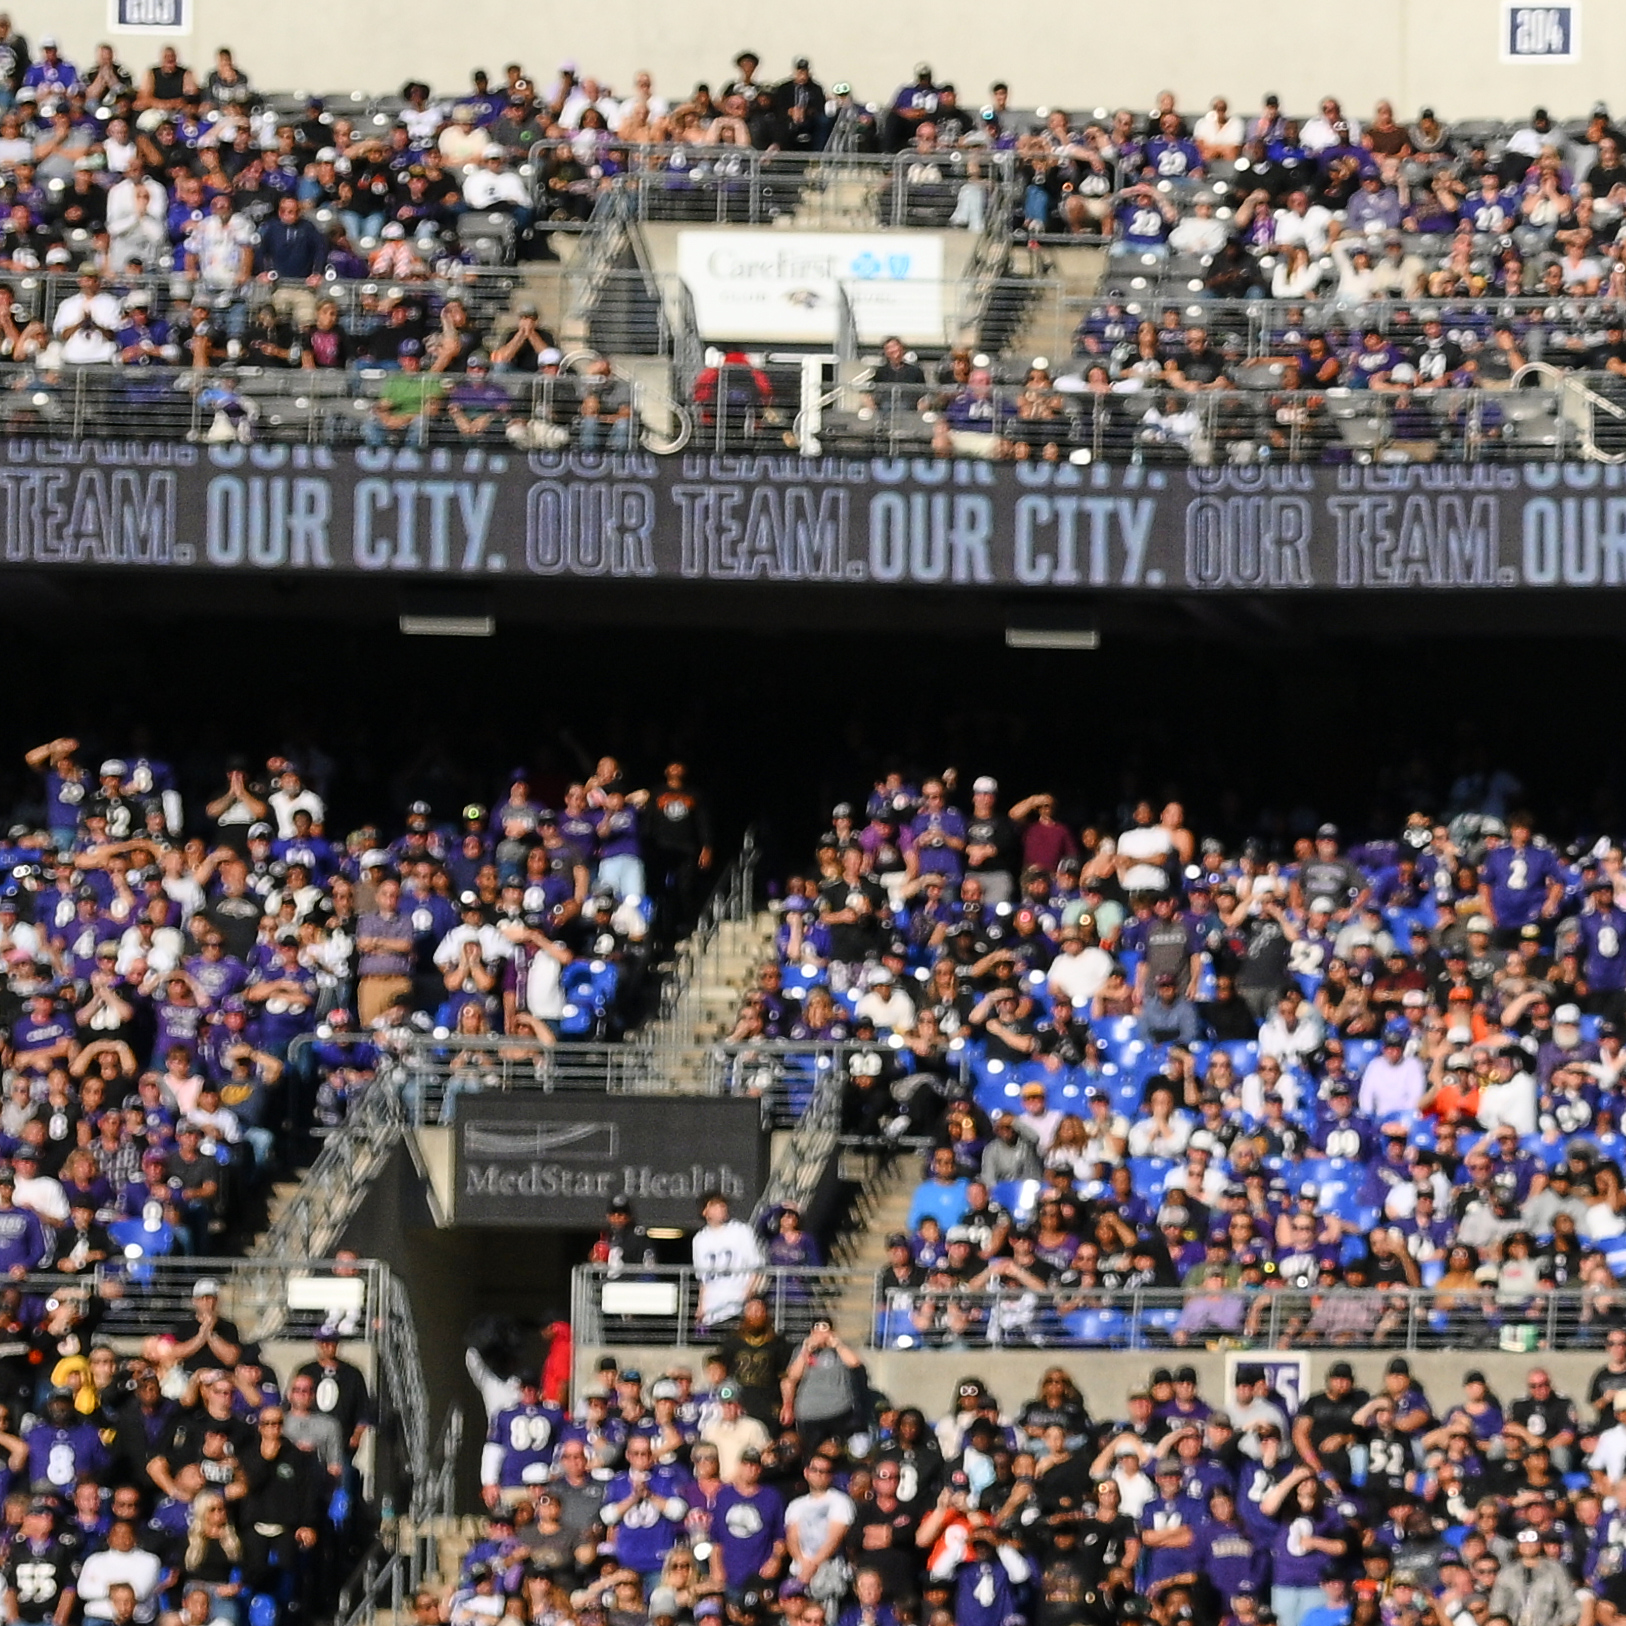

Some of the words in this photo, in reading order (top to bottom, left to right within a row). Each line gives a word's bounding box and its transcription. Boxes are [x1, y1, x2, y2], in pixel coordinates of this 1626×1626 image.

[1516, 9, 1563, 53] 204
[707, 246, 837, 280] CareFirst
[205, 476, 334, 569] OUR
[353, 476, 505, 572] CITY.
[525, 482, 655, 578] OUR
[673, 486, 866, 584] TEAM.
[869, 491, 999, 585] OUR
[1013, 494, 1165, 586] CITY.
[1186, 495, 1312, 588] OUR
[1328, 495, 1520, 588] TEAM.
[1507, 859, 1528, 890] 2
[465, 1162, 610, 1197] MedStar
[623, 1164, 744, 1199] Health
[48, 1443, 75, 1485] 8
